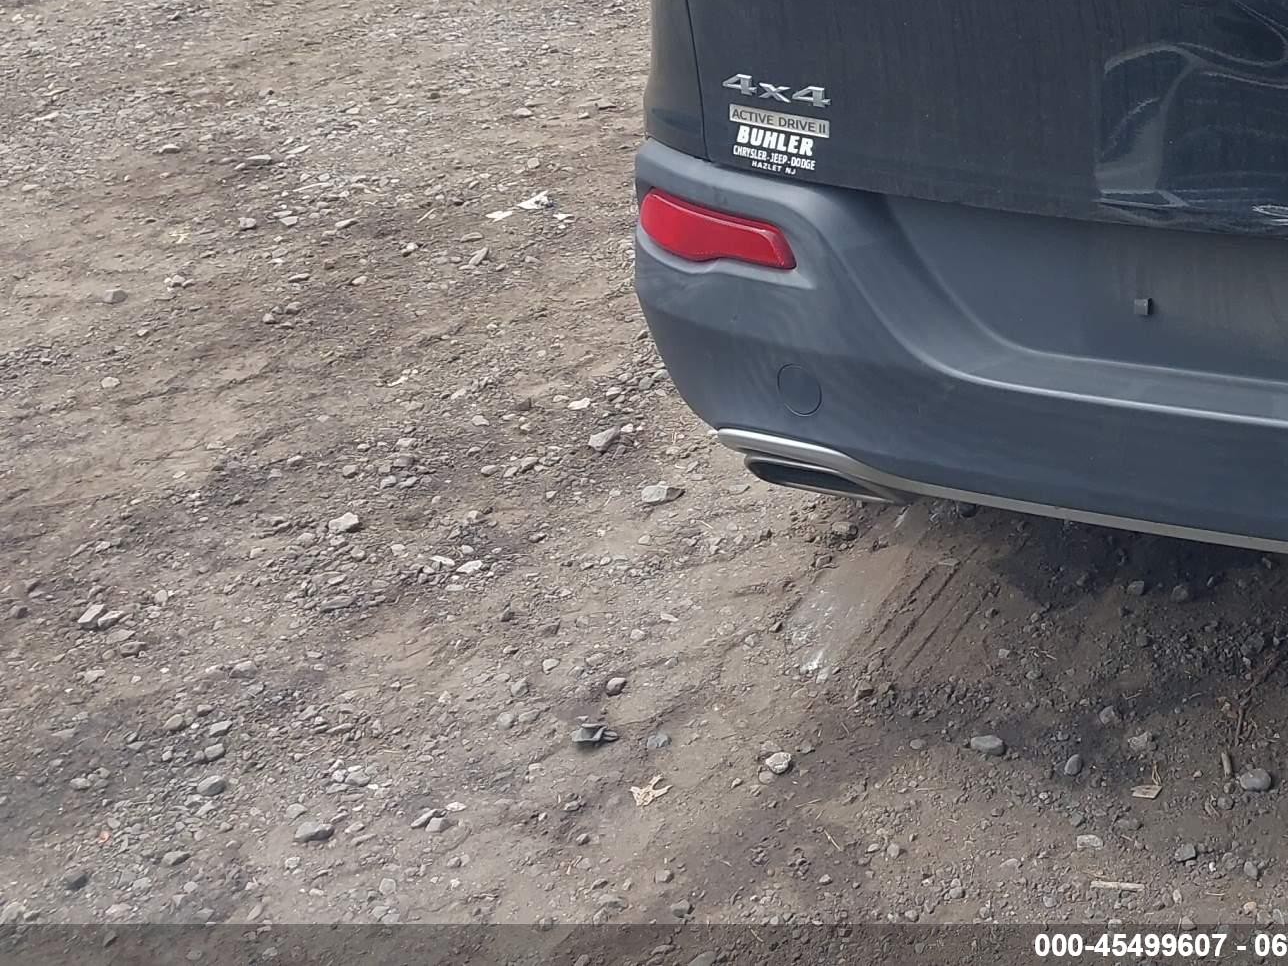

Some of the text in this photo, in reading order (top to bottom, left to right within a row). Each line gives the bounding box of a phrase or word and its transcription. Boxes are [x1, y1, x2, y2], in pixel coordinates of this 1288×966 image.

[731, 108, 827, 134] ACTIVE DRIVE II
[736, 124, 814, 157] BUHLER
[751, 160, 797, 175] HAZLET NJ
